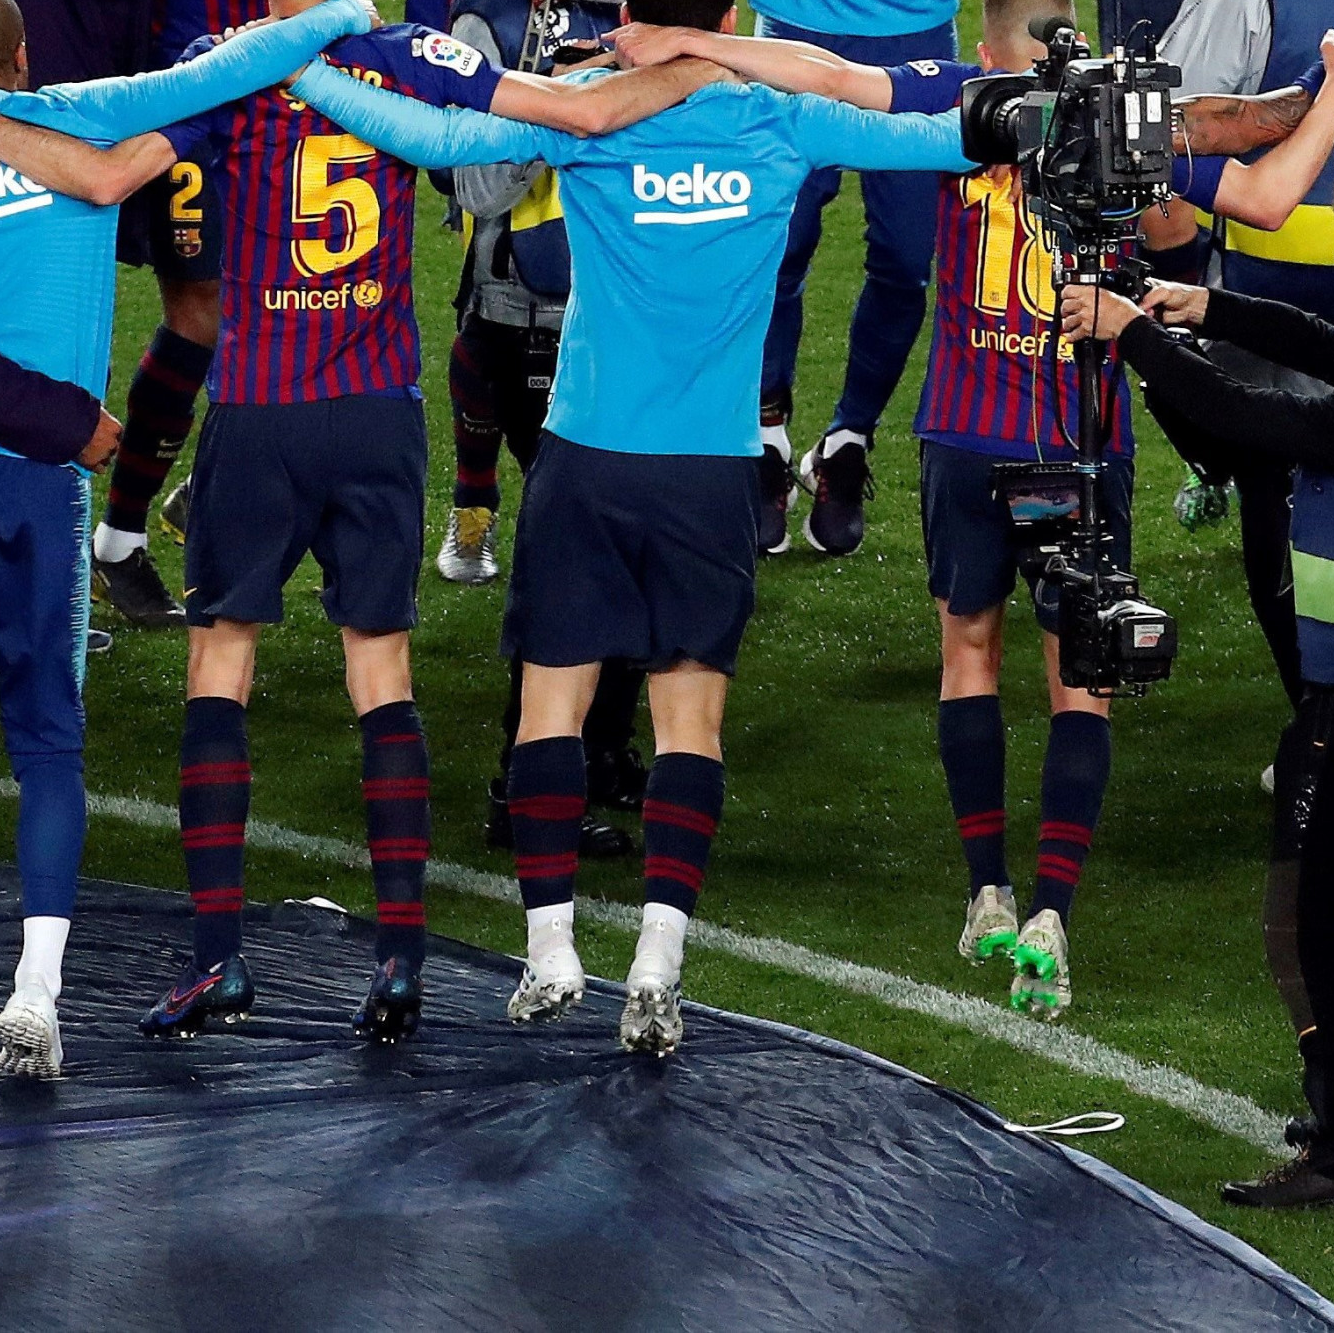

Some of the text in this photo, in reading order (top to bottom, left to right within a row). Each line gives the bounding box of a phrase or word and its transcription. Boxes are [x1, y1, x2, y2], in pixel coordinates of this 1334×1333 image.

[171, 161, 203, 222] 2
[290, 132, 380, 278] 5
[633, 163, 751, 205] beko
[264, 283, 351, 310] unicef
[970, 325, 1051, 357] unicef
